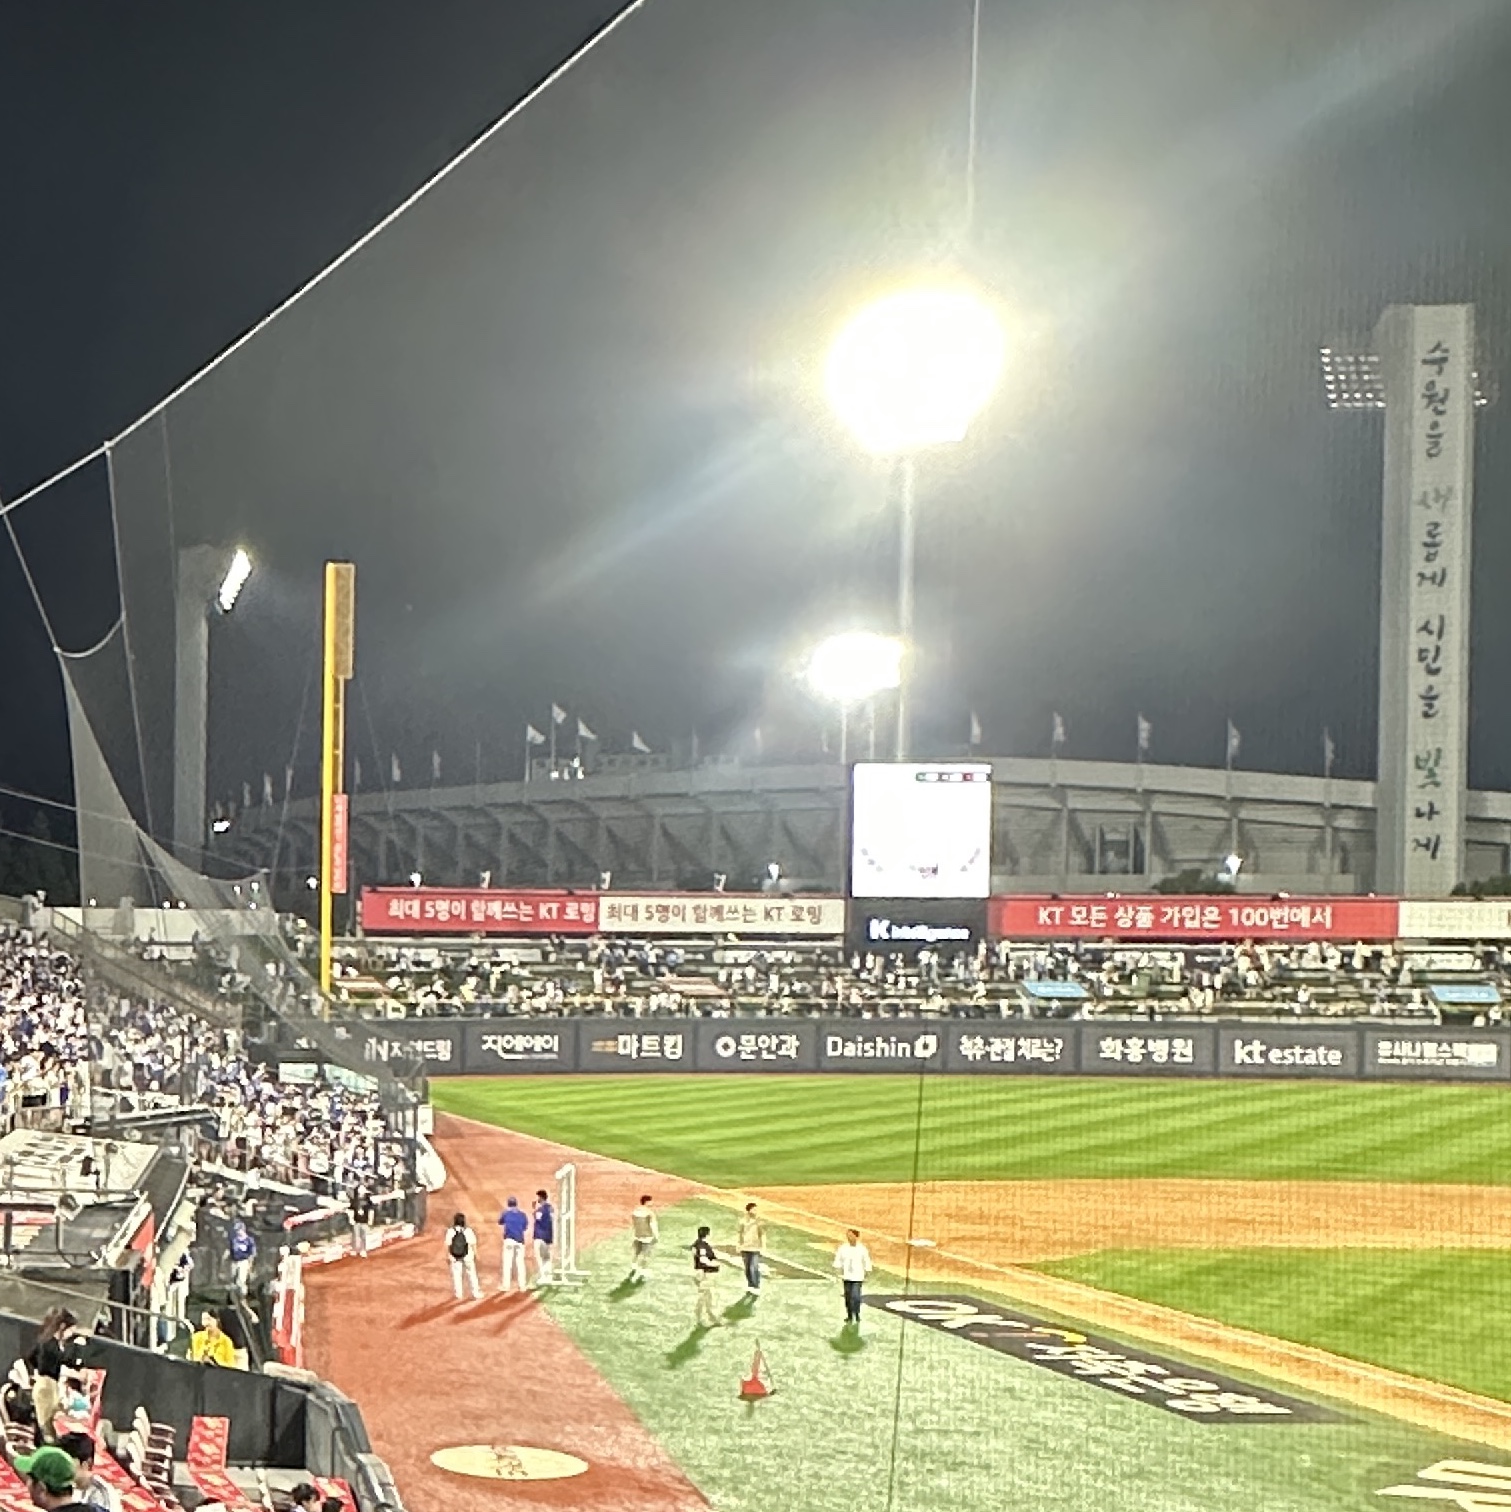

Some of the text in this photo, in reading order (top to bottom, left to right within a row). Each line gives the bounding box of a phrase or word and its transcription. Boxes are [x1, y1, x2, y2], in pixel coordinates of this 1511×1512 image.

[1416, 614, 1445, 719] 시민을
[388, 898, 421, 920] 최대
[425, 899, 467, 922] 5명이
[539, 902, 561, 920] KT
[563, 901, 596, 923] 로밍
[606, 903, 638, 923] 최대
[644, 903, 687, 924] 5명이
[763, 905, 785, 922] KT
[791, 904, 823, 925] 로밍
[1038, 905, 1333, 931] KT 모든 상품 가입은 100번에서
[617, 1034, 683, 1060] 마트킹
[738, 1034, 800, 1060] 문안과
[826, 1034, 911, 1058] Daishin
[1099, 1036, 1194, 1063] 화홍병원
[1234, 1038, 1343, 1066] kt estate
